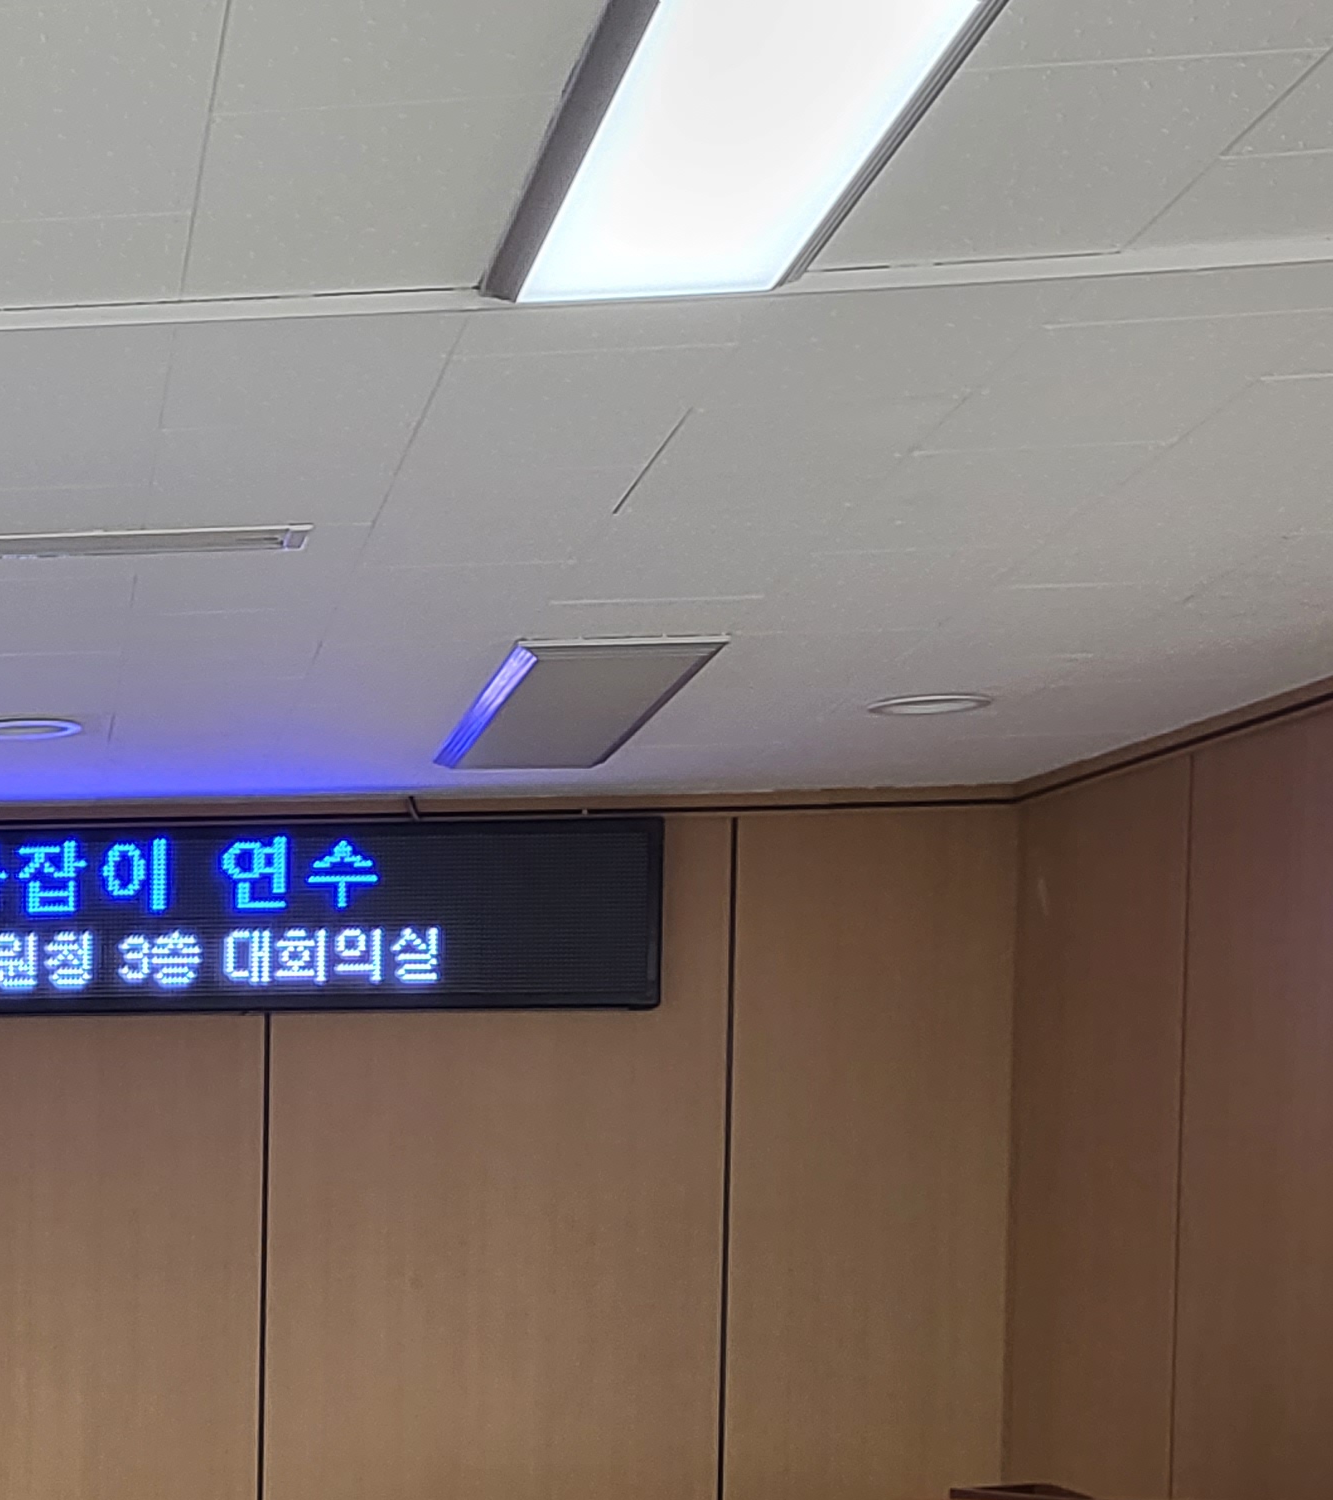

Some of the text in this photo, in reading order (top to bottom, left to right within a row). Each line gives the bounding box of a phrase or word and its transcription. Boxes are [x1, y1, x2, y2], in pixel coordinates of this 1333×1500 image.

[220, 834, 381, 911] 연수
[119, 928, 203, 989] 3층
[223, 925, 442, 986] 대회의실
